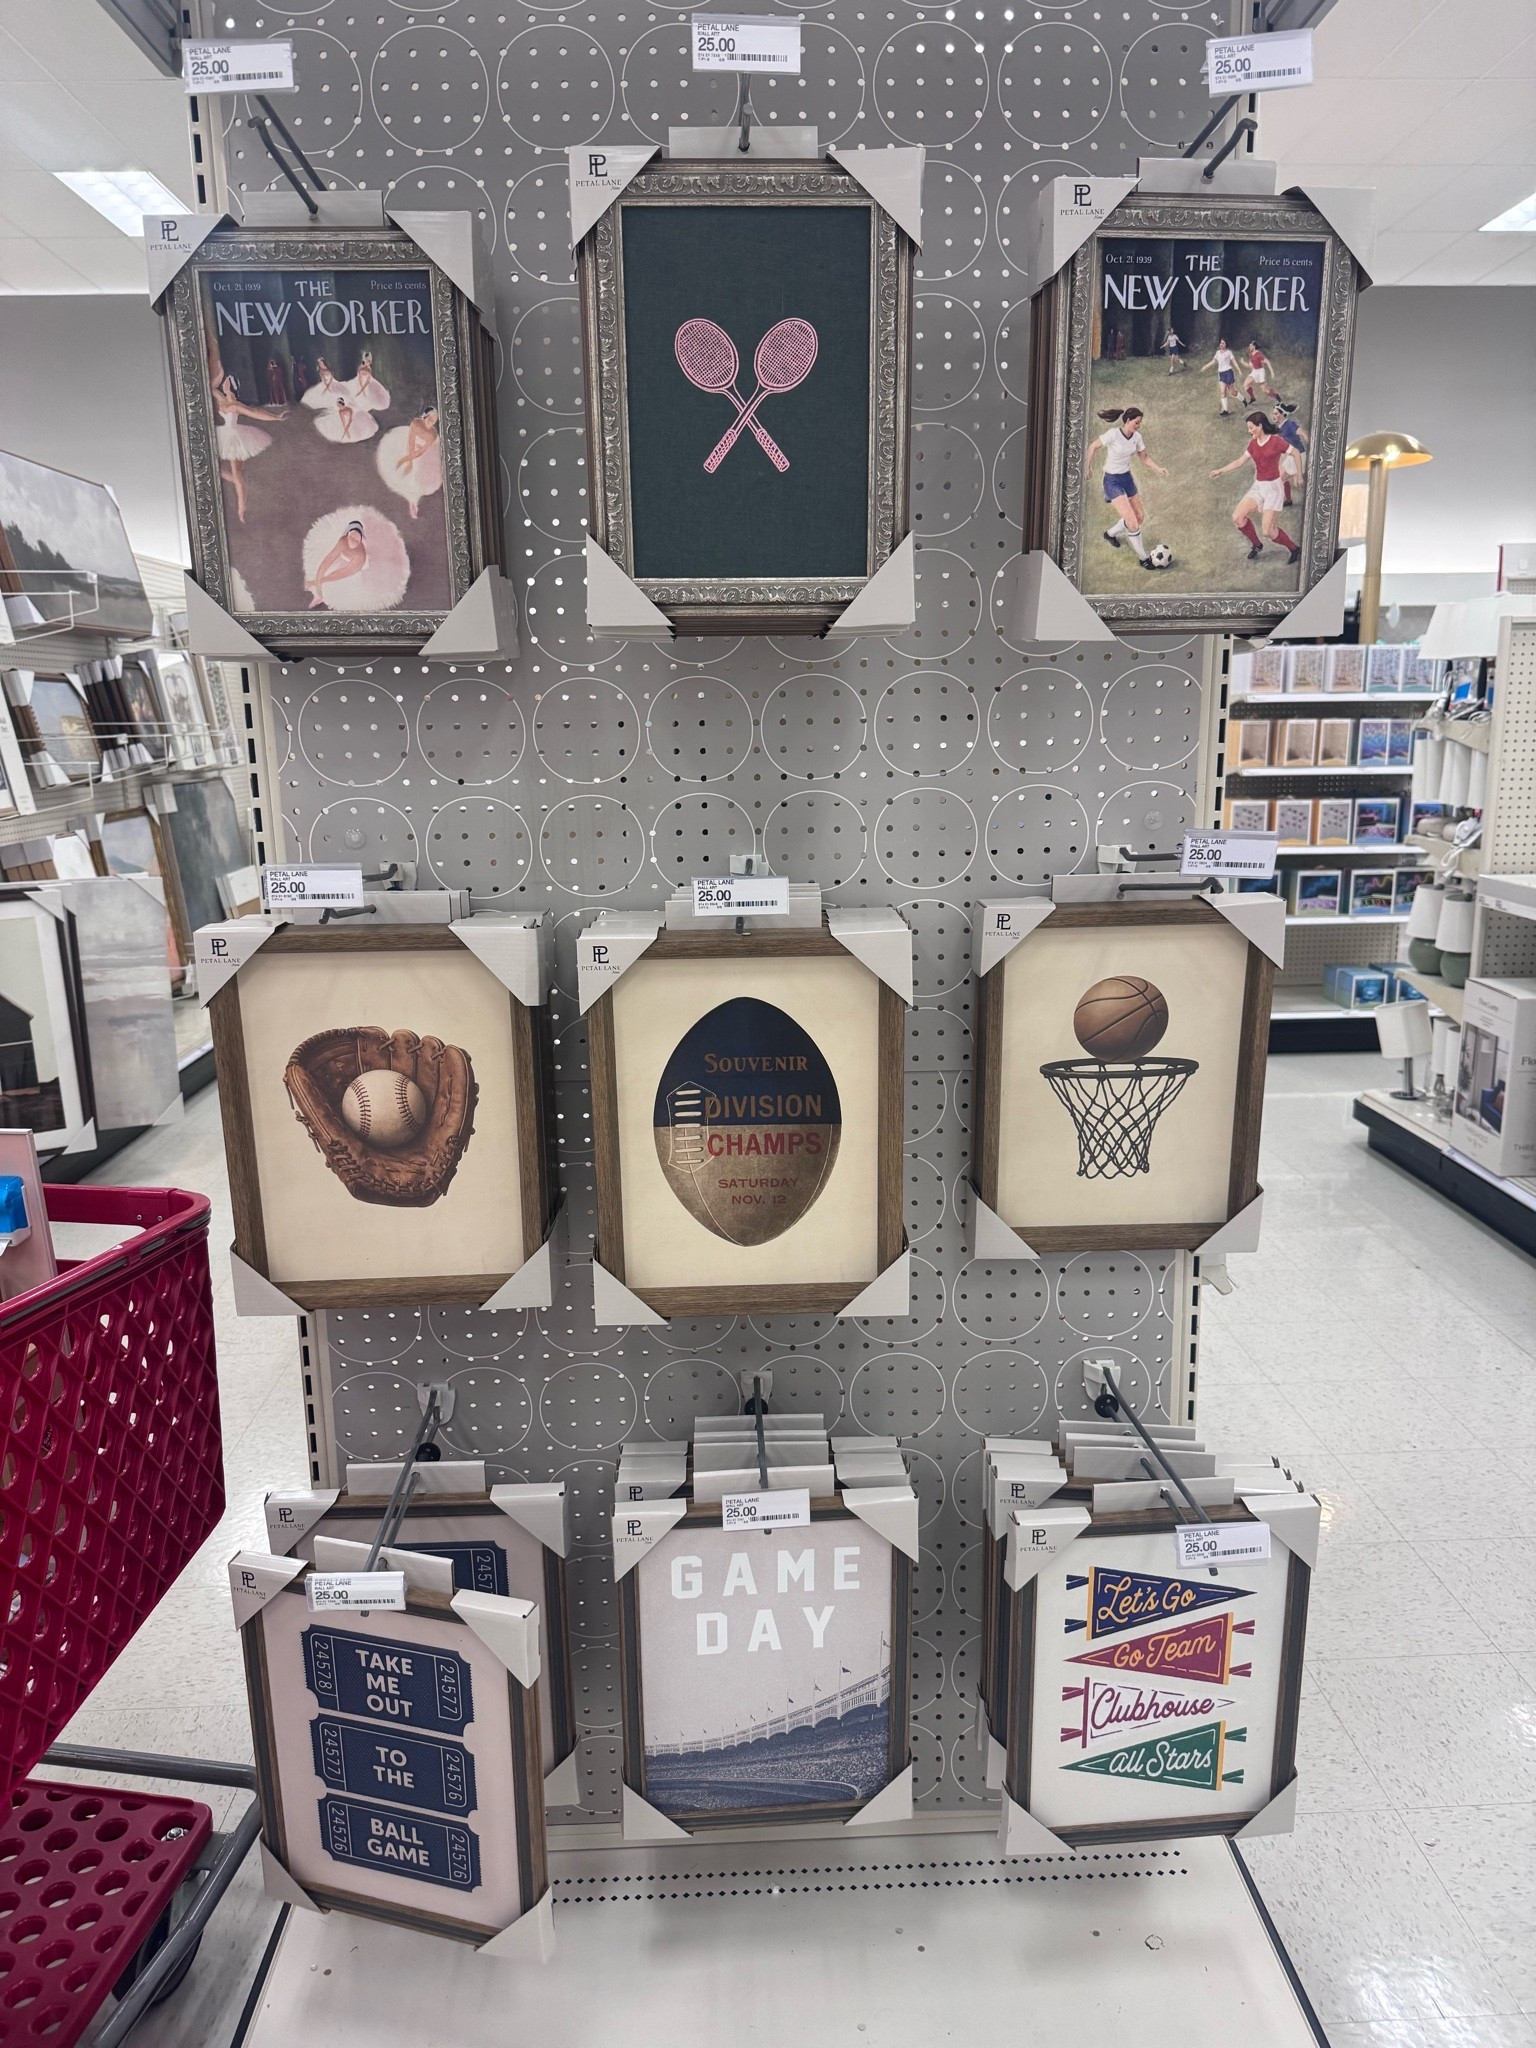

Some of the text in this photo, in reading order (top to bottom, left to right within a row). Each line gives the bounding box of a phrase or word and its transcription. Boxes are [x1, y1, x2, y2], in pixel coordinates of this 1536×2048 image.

[721, 24, 740, 32] LANE
[189, 46, 231, 55] PETAL LANE
[698, 37, 736, 52] 25.00
[1214, 44, 1254, 54] PETAL LANE
[191, 60, 229, 76] 25.00
[1215, 58, 1251, 75] 25.00
[1106, 254, 1124, 264] Oct.
[1136, 256, 1152, 264] 1939
[1185, 255, 1221, 272] THE
[1259, 256, 1313, 267] Price 15 cents
[213, 282, 231, 291] Oct.
[245, 283, 261, 291] 1939
[295, 280, 333, 297] THE
[370, 280, 426, 290] Price 15 cents
[1104, 274, 1309, 313] NEW YORKER
[215, 300, 430, 337] NEW YORKER
[1189, 848, 1222, 861] 25.00
[271, 881, 306, 894] 25.00
[698, 890, 731, 901] 25.00
[704, 1094, 821, 1119] DIVISION
[707, 1132, 822, 1157] CHAMPS
[718, 1178, 798, 1189] SATURDAY
[731, 1195, 786, 1205] NOV. 12
[726, 1506, 757, 1518] 25.00
[1185, 1540, 1217, 1554] 25.00
[477, 1555, 494, 1594] 2457
[671, 1546, 860, 1600] GAME
[315, 1590, 349, 1600] 25.00
[1162, 1582, 1196, 1612] Go
[696, 1606, 835, 1655] DAY
[1114, 1629, 1217, 1668] Go Team
[315, 1640, 332, 1690] 24578
[355, 1649, 414, 1676] TAKE
[366, 1672, 400, 1695] ME
[440, 1664, 458, 1715] 24577
[366, 1694, 413, 1718] OUT
[1091, 1687, 1215, 1730] Clubhouse
[324, 1728, 341, 1775] 24577
[375, 1746, 407, 1767] TO
[1146, 1741, 1213, 1777] Stars
[373, 1765, 414, 1789] THE
[445, 1753, 463, 1801] 24576
[331, 1807, 348, 1852] 24576
[370, 1818, 424, 1846] BALL
[367, 1838, 430, 1867] GAME
[451, 1833, 467, 1879] 24576
